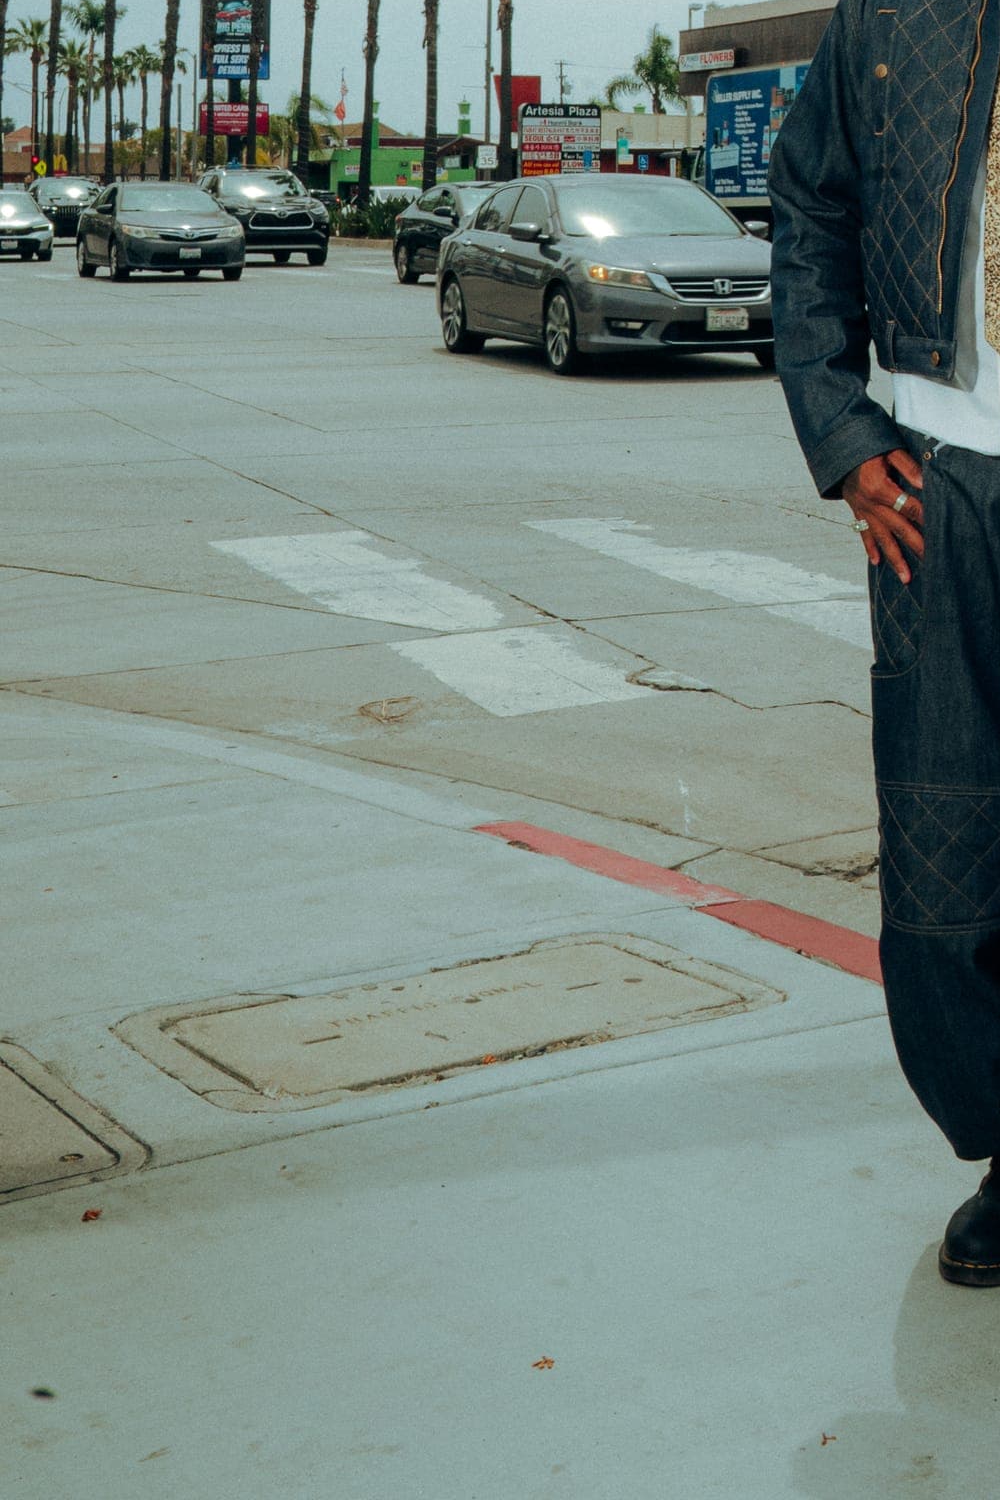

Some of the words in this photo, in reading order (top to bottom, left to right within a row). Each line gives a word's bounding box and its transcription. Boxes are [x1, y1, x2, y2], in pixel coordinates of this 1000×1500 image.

[701, 51, 734, 64] FLOWERS
[525, 106, 564, 116] Artesia
[569, 106, 598, 116] Plaza
[482, 156, 494, 166] 35
